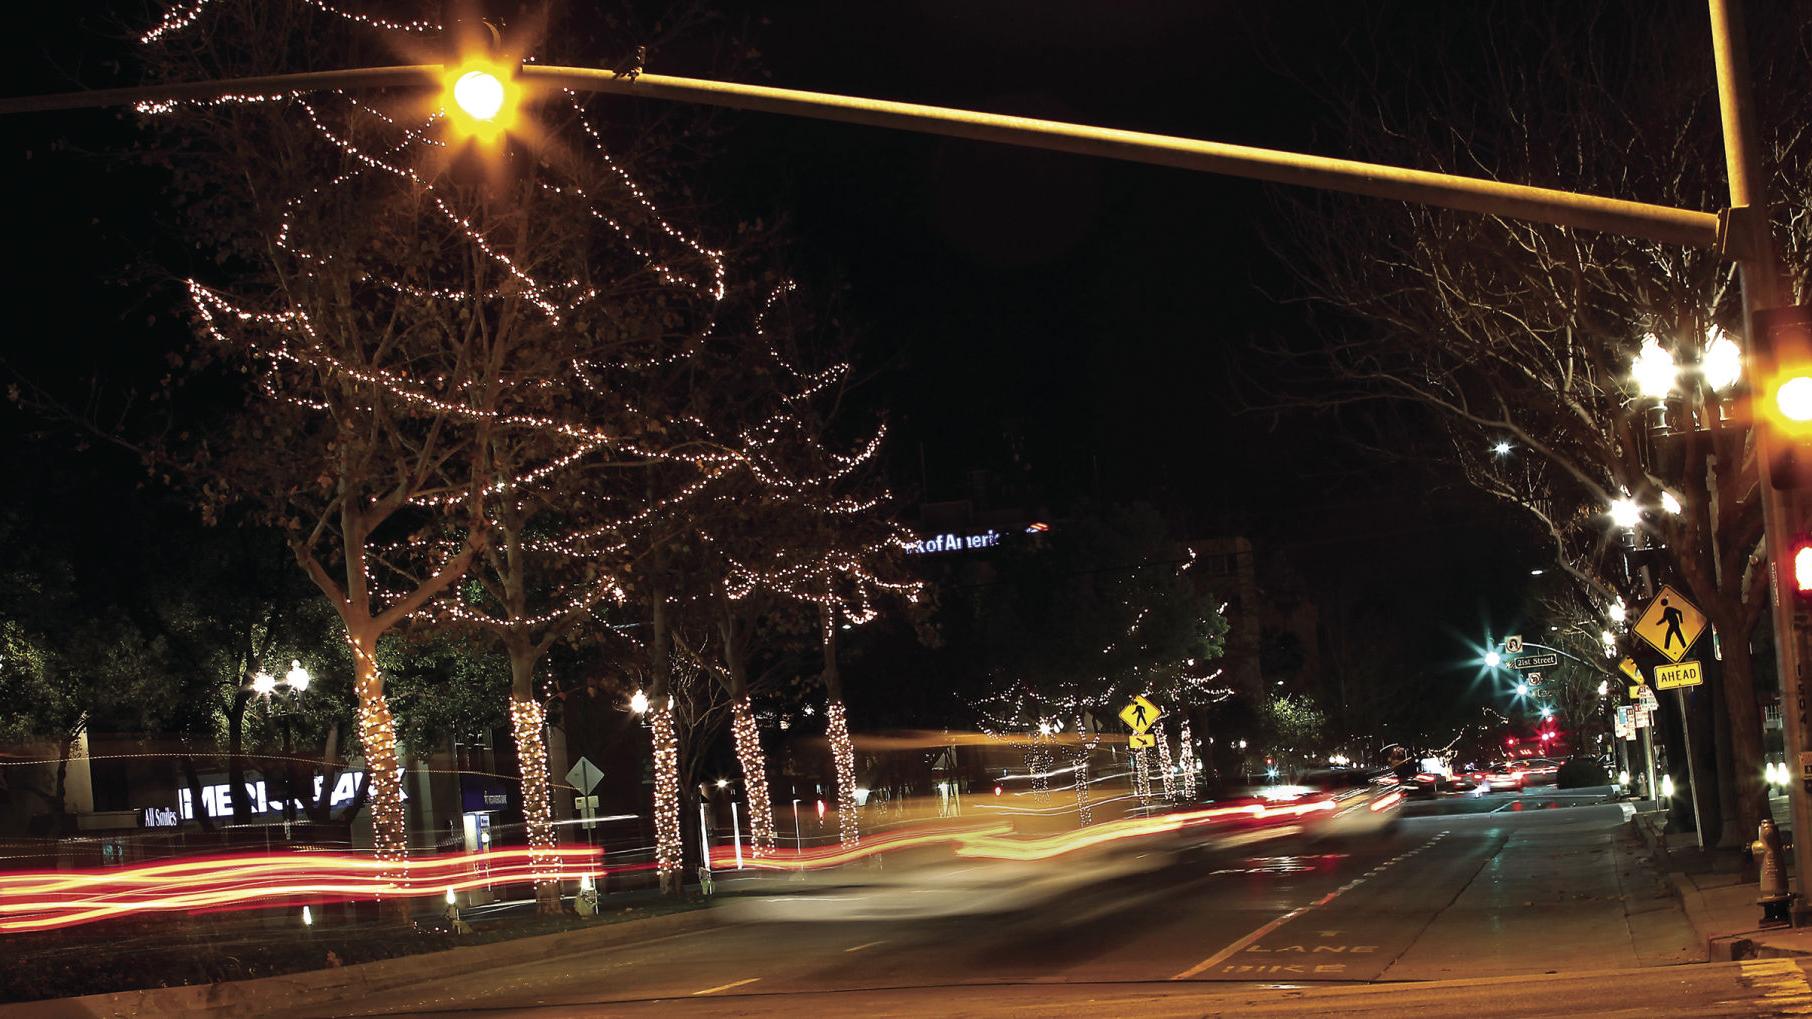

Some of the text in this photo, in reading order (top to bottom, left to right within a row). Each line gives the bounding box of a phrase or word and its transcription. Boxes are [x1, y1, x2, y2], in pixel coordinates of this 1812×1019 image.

[926, 535, 943, 553] of
[1517, 656, 1555, 667] 21st Street
[1661, 668, 1697, 683] AHEAD
[144, 807, 178, 827] All Smiles
[1246, 945, 1380, 953] LANE
